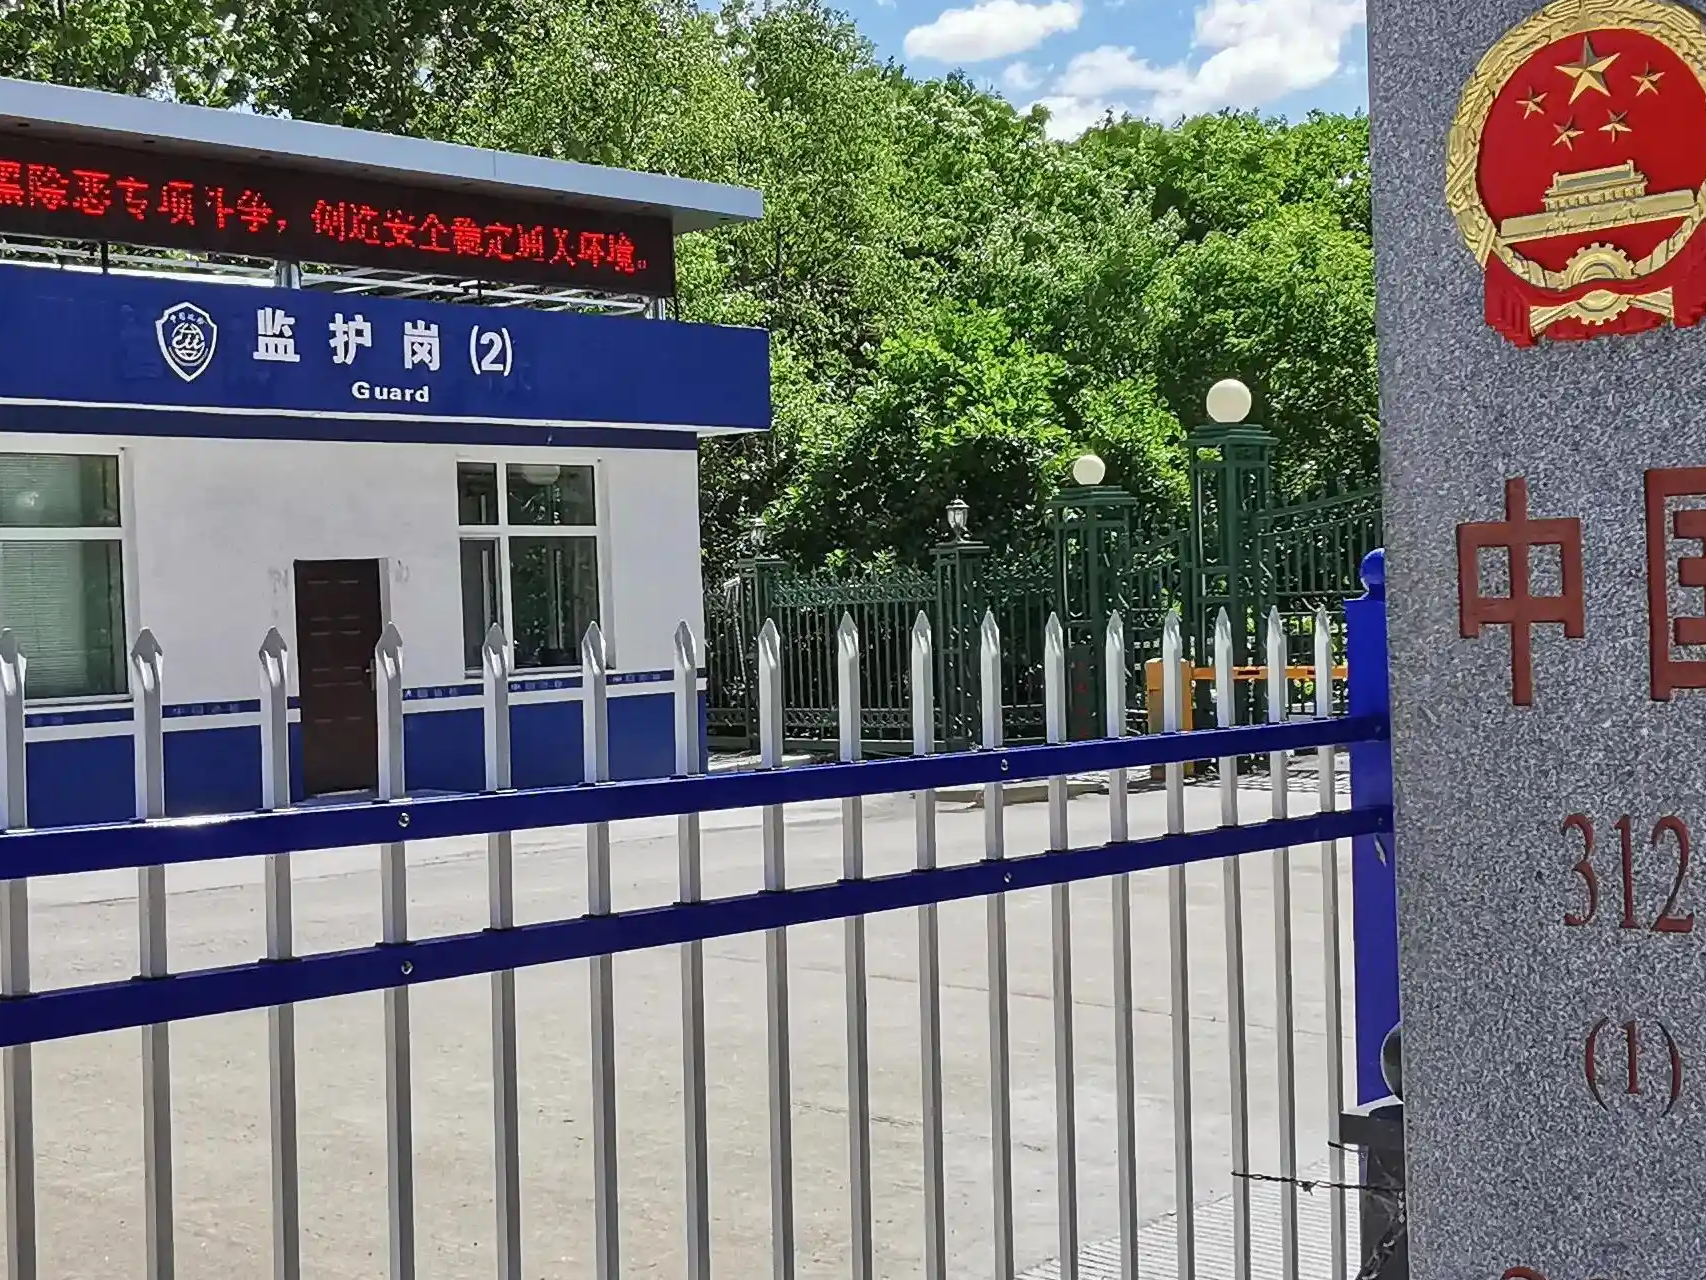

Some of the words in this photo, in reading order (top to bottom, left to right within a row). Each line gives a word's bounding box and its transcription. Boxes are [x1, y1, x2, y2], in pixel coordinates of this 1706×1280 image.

[351, 380, 430, 403] Guard
[1561, 813, 1694, 933] 312
[1584, 1017, 1683, 1118] (1)
